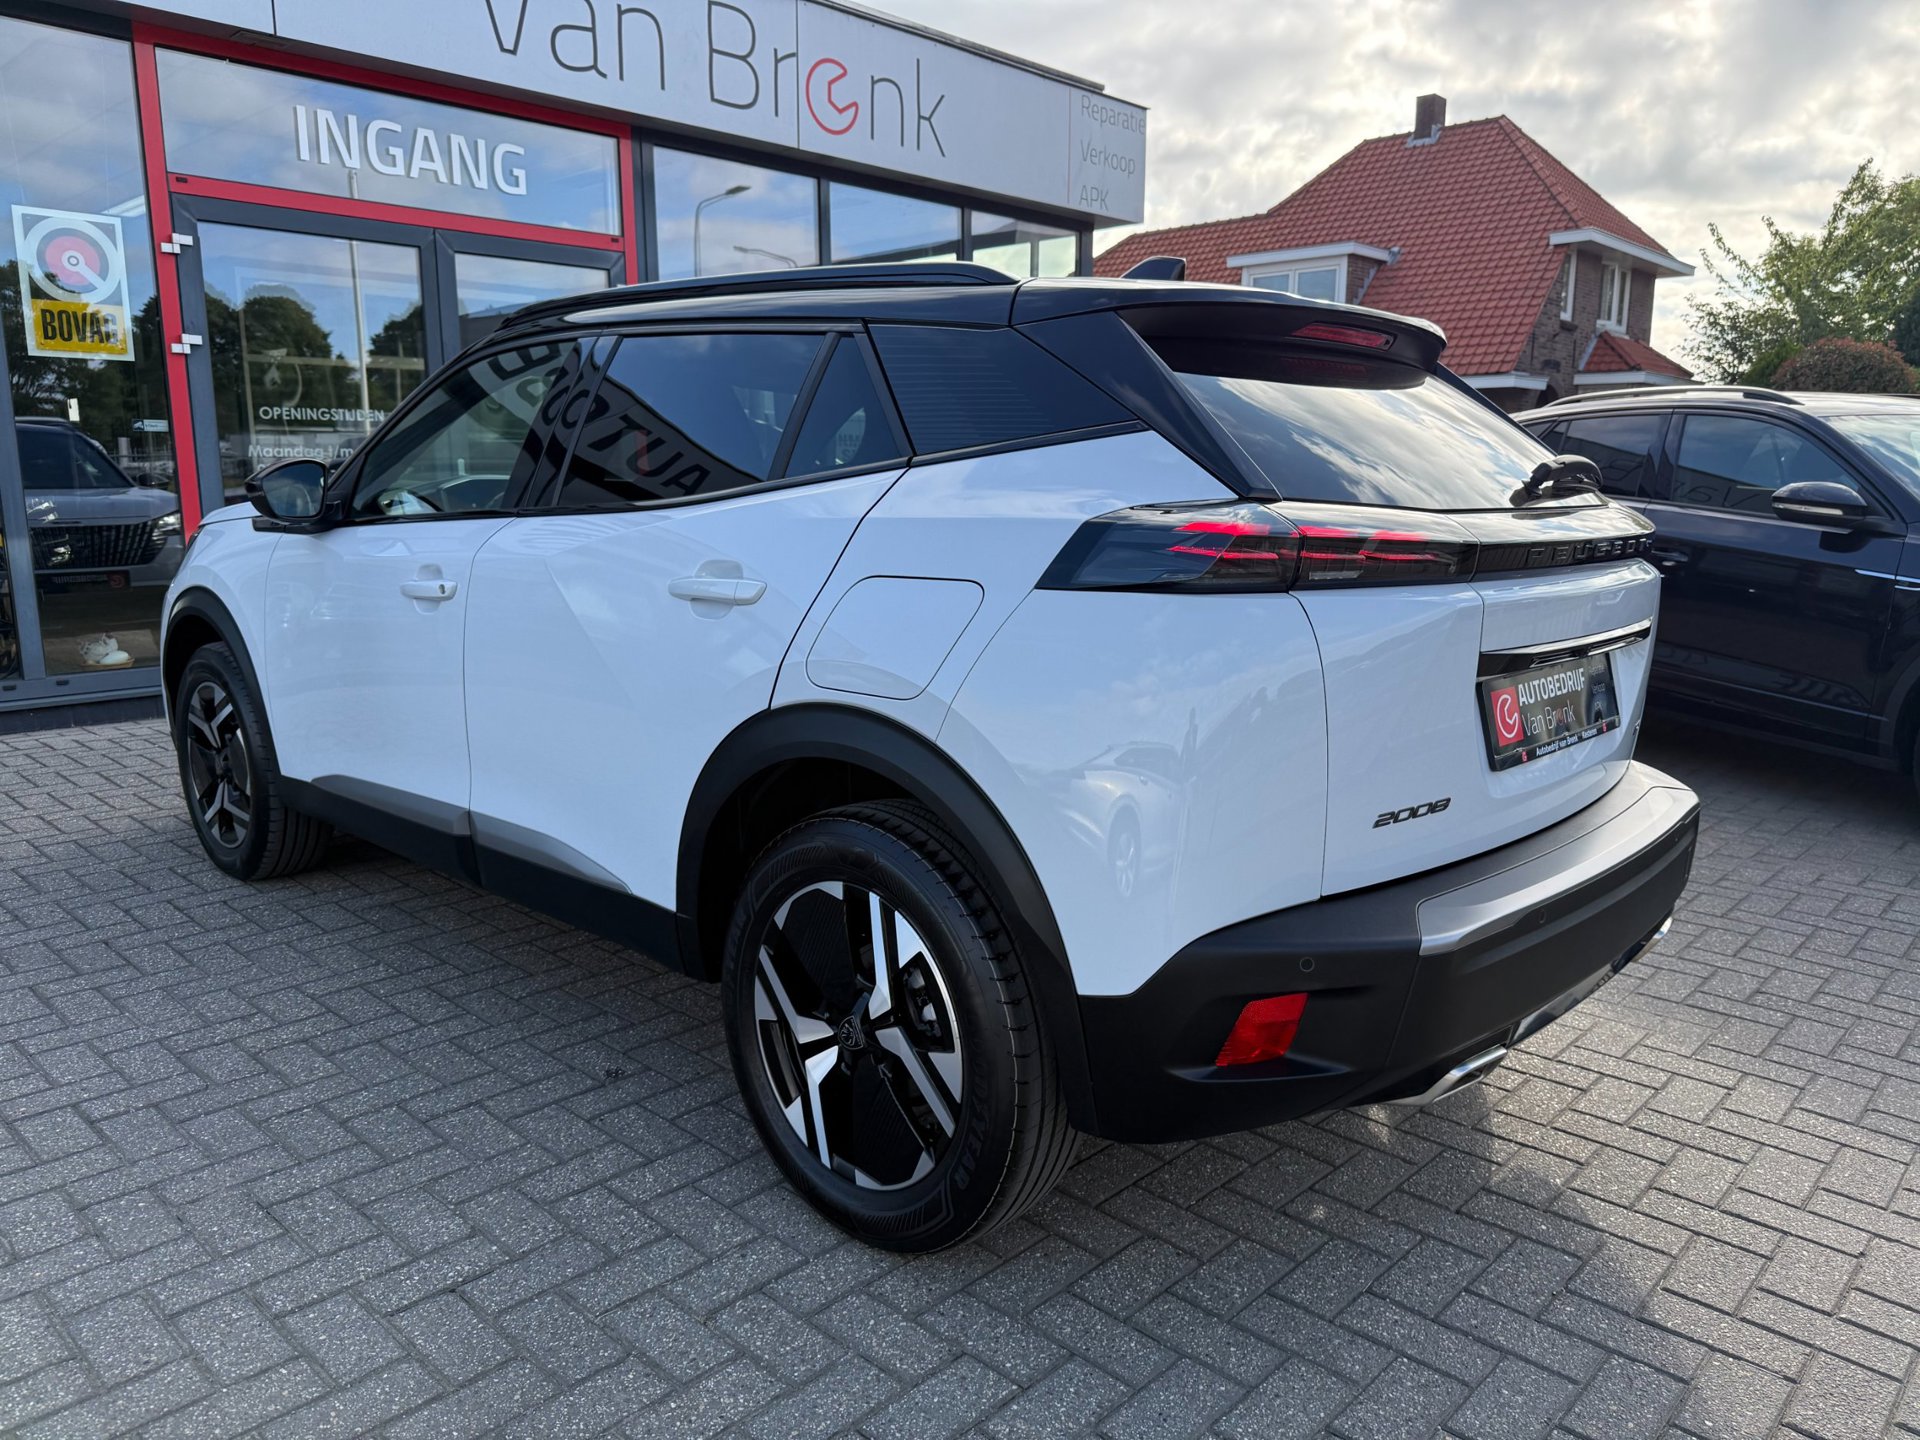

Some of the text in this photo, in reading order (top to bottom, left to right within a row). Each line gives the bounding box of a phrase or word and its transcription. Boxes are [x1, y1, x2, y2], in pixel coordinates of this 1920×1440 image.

[1081, 94, 1145, 135] Reparatie
[293, 104, 528, 196] INGANG
[1080, 139, 1136, 179] Verkoop
[1079, 185, 1109, 212] APK
[40, 308, 119, 345] BOVAG
[259, 406, 385, 422] OPENINGSTIJDEN
[248, 445, 324, 460] Maandag
[1526, 538, 1648, 567] PEUGEOT
[1518, 668, 1586, 706] AUTOBEDRIJF
[1522, 711, 1545, 736] Van
[1372, 797, 1451, 829] 2008
